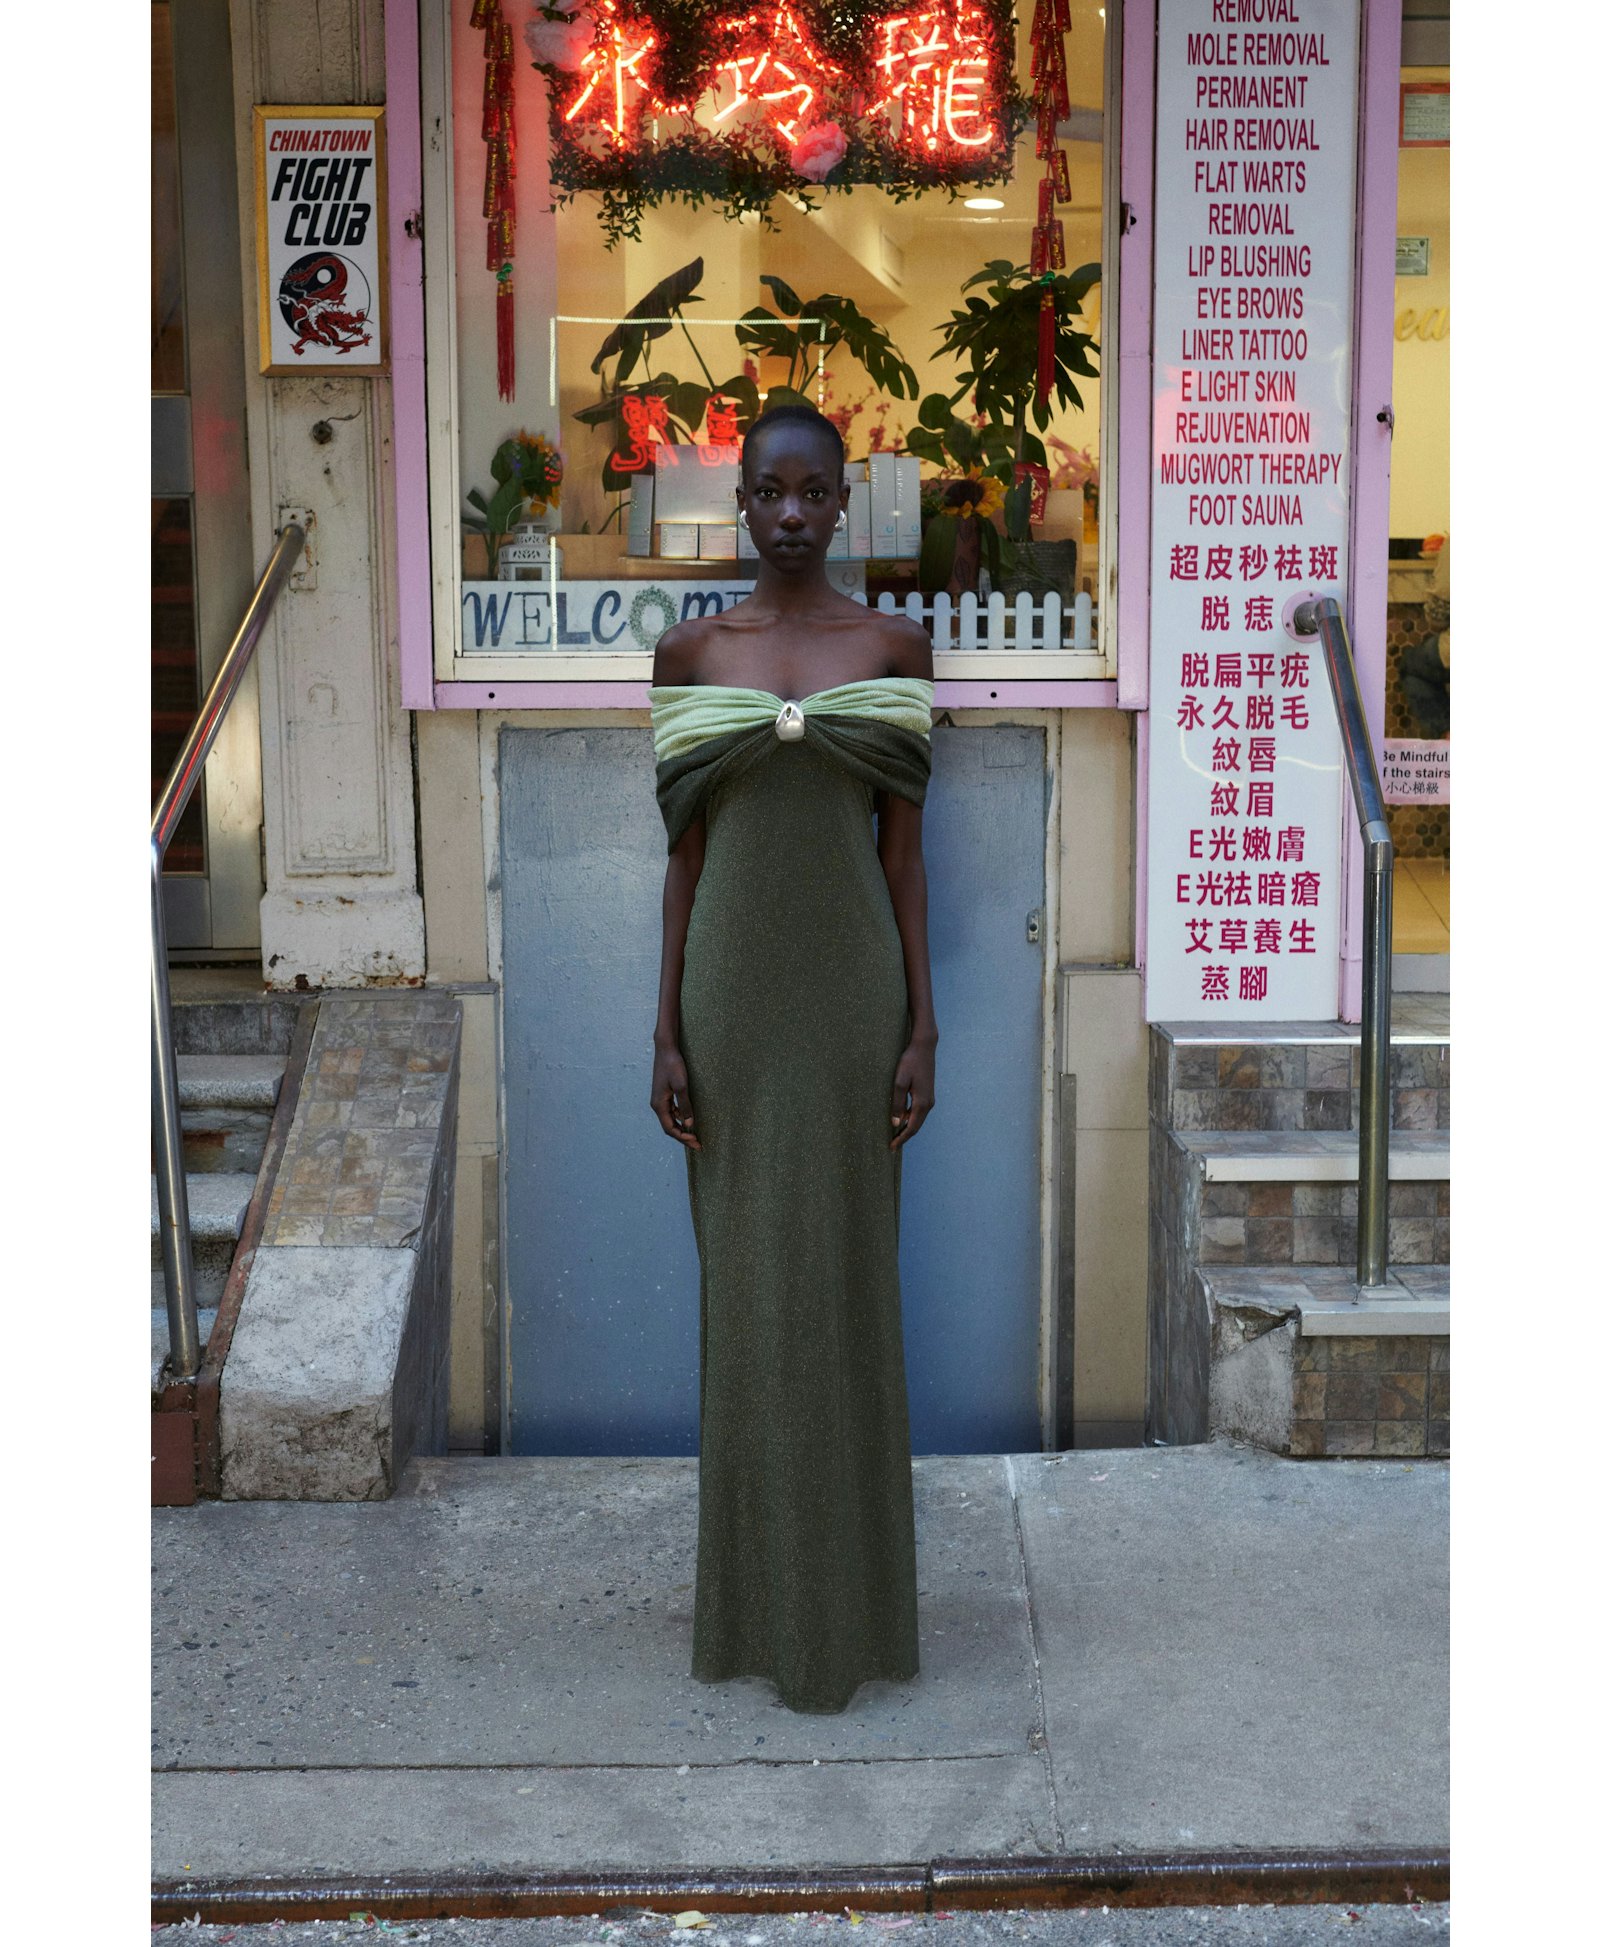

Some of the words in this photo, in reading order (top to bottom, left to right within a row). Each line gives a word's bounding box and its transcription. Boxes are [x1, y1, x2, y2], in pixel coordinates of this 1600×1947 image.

[1212, 0, 1299, 23] REMOVAL
[1187, 33, 1238, 66] MOLE
[1243, 33, 1329, 66] REMOVAL
[1196, 75, 1308, 109] PERMANENT
[269, 130, 372, 152] CHINATOWN
[1185, 118, 1229, 151] HAIR
[1233, 118, 1320, 151] REMOVAL
[271, 158, 373, 201] FIGHT
[1195, 160, 1239, 193] FLAT
[1243, 160, 1306, 193] WARTS
[284, 203, 371, 246] CLUB
[1208, 203, 1294, 236] REMOVAL
[1188, 245, 1215, 278] LIP
[1220, 245, 1311, 278] BLUSHING
[1197, 287, 1232, 320] EYE
[1237, 287, 1304, 320] BROWS
[1182, 329, 1234, 361] LINER
[1239, 328, 1308, 361] TATTOO
[1181, 371, 1193, 403] E
[1198, 370, 1250, 403] LIGHT
[1254, 370, 1296, 402] SKIN
[1176, 411, 1310, 444] REJUVENATION
[1161, 452, 1255, 485] MUGWORT
[1259, 453, 1342, 485] THERAPY
[1189, 494, 1237, 526] FOOT
[1241, 494, 1304, 526] SAUNA
[1169, 544, 1339, 582] 超皮秒祛斑
[462, 586, 754, 649] WELCOM
[1176, 694, 1310, 731] 永久脱毛
[1212, 736, 1277, 773] 紋唇
[1400, 750, 1449, 762] Mindful
[1391, 766, 1411, 778] the
[1415, 766, 1450, 778] stairs
[1210, 781, 1274, 818] 紋眉
[1189, 825, 1305, 863] E光嫩膚
[1184, 918, 1317, 955] 艾草養生
[1201, 965, 1268, 1001] 蒸腳
